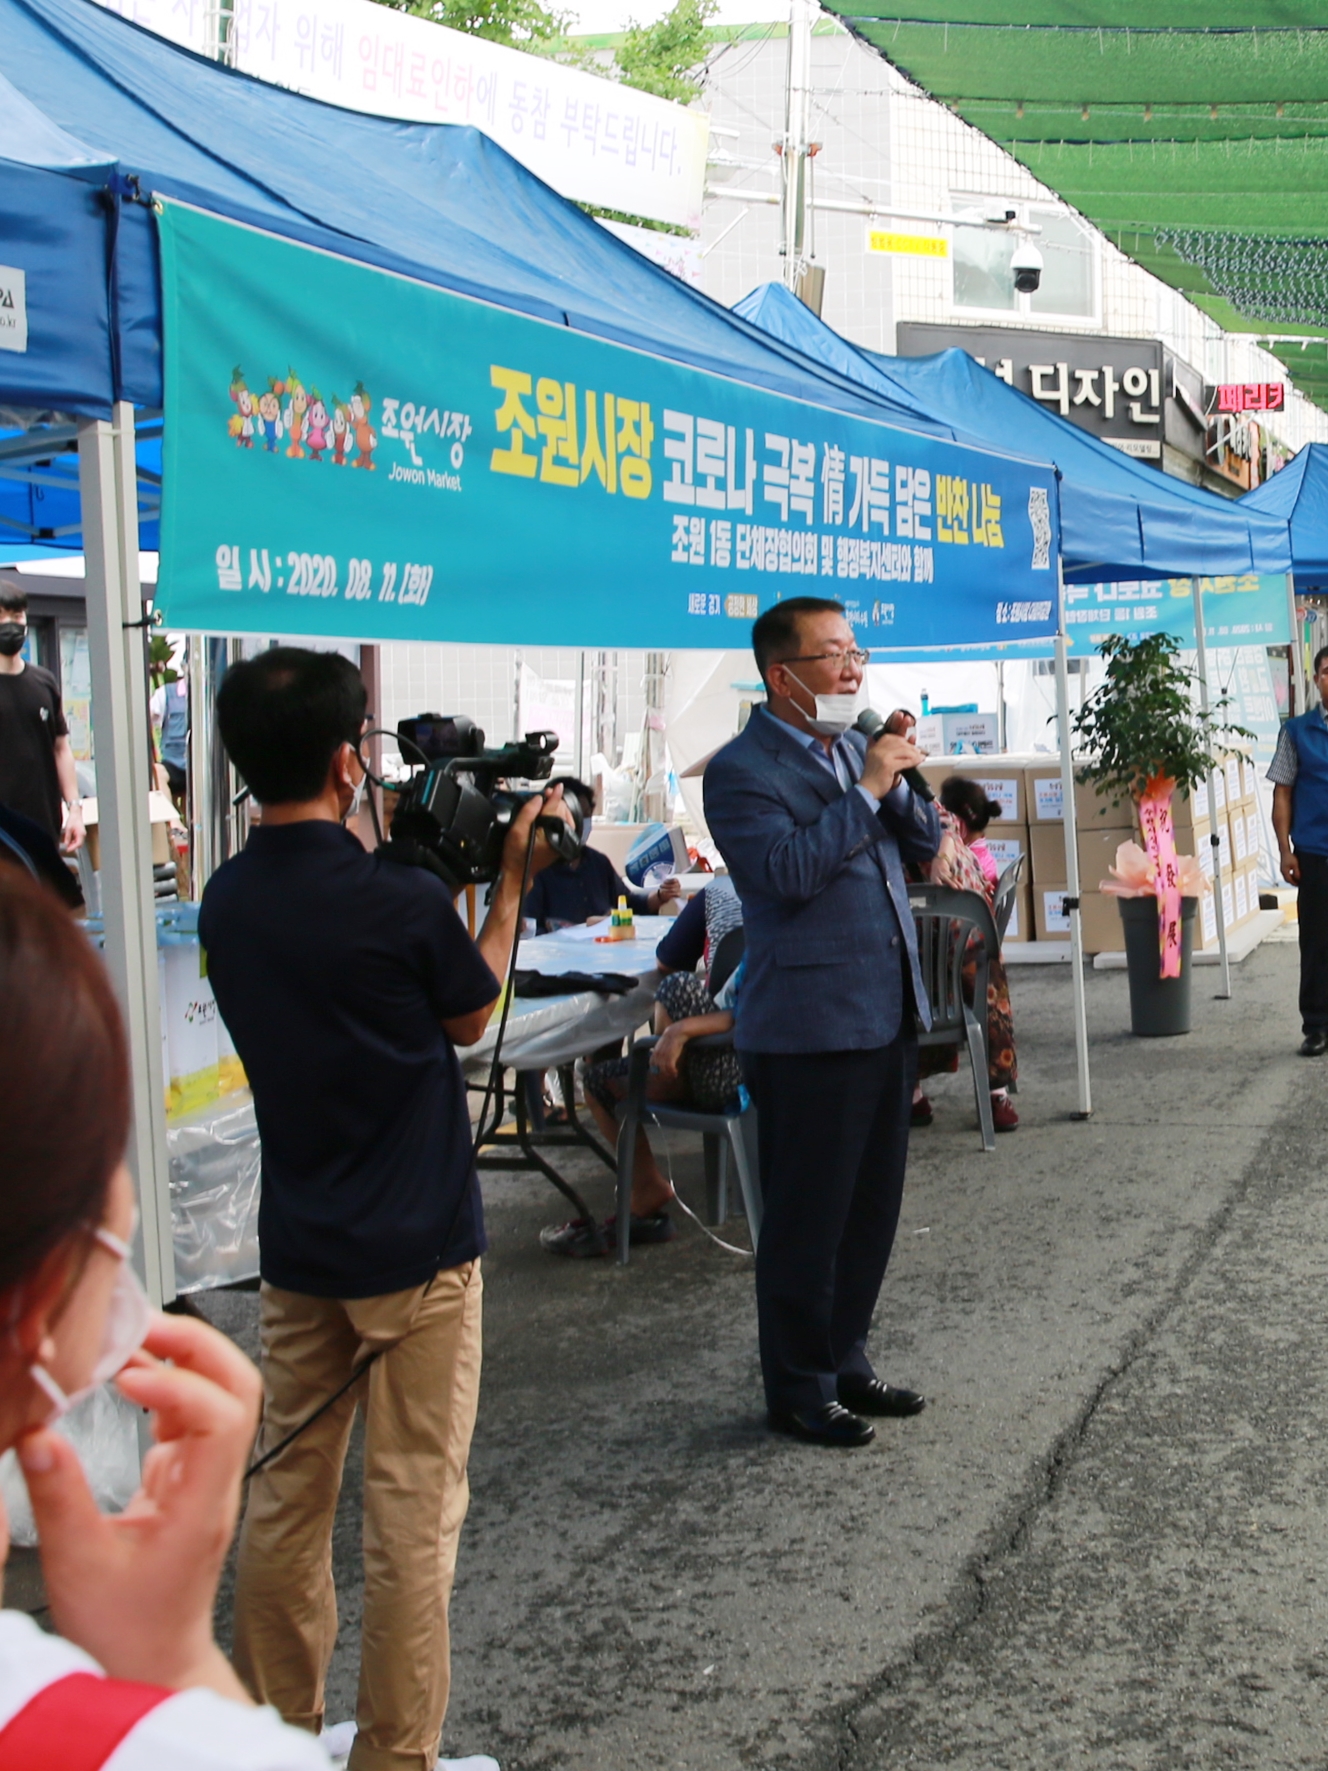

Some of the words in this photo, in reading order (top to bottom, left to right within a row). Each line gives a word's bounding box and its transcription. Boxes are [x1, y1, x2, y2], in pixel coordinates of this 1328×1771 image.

[294, 14, 343, 80] 위해
[358, 34, 497, 126] 임대료인하에
[509, 80, 550, 141] 동참
[560, 96, 682, 176] 부탁드립니다.
[1029, 361, 1160, 423] 디자인
[381, 397, 472, 469] 조원시장
[490, 364, 654, 500] 조원시장
[663, 408, 757, 516] 코로나
[763, 432, 816, 526] 극복
[821, 442, 845, 526] 情
[848, 455, 890, 537] 가득
[895, 465, 932, 541] 담은
[936, 474, 969, 545] 반찬
[971, 483, 1004, 548] 나눔
[388, 462, 425, 485] Jowon
[427, 469, 462, 491] Market
[671, 514, 706, 566] 조원
[709, 520, 732, 569] 1동
[736, 523, 818, 575] 단체장협의회
[821, 535, 834, 577] 및
[836, 536, 912, 582] 행정복지센터와
[913, 545, 935, 584] 함께
